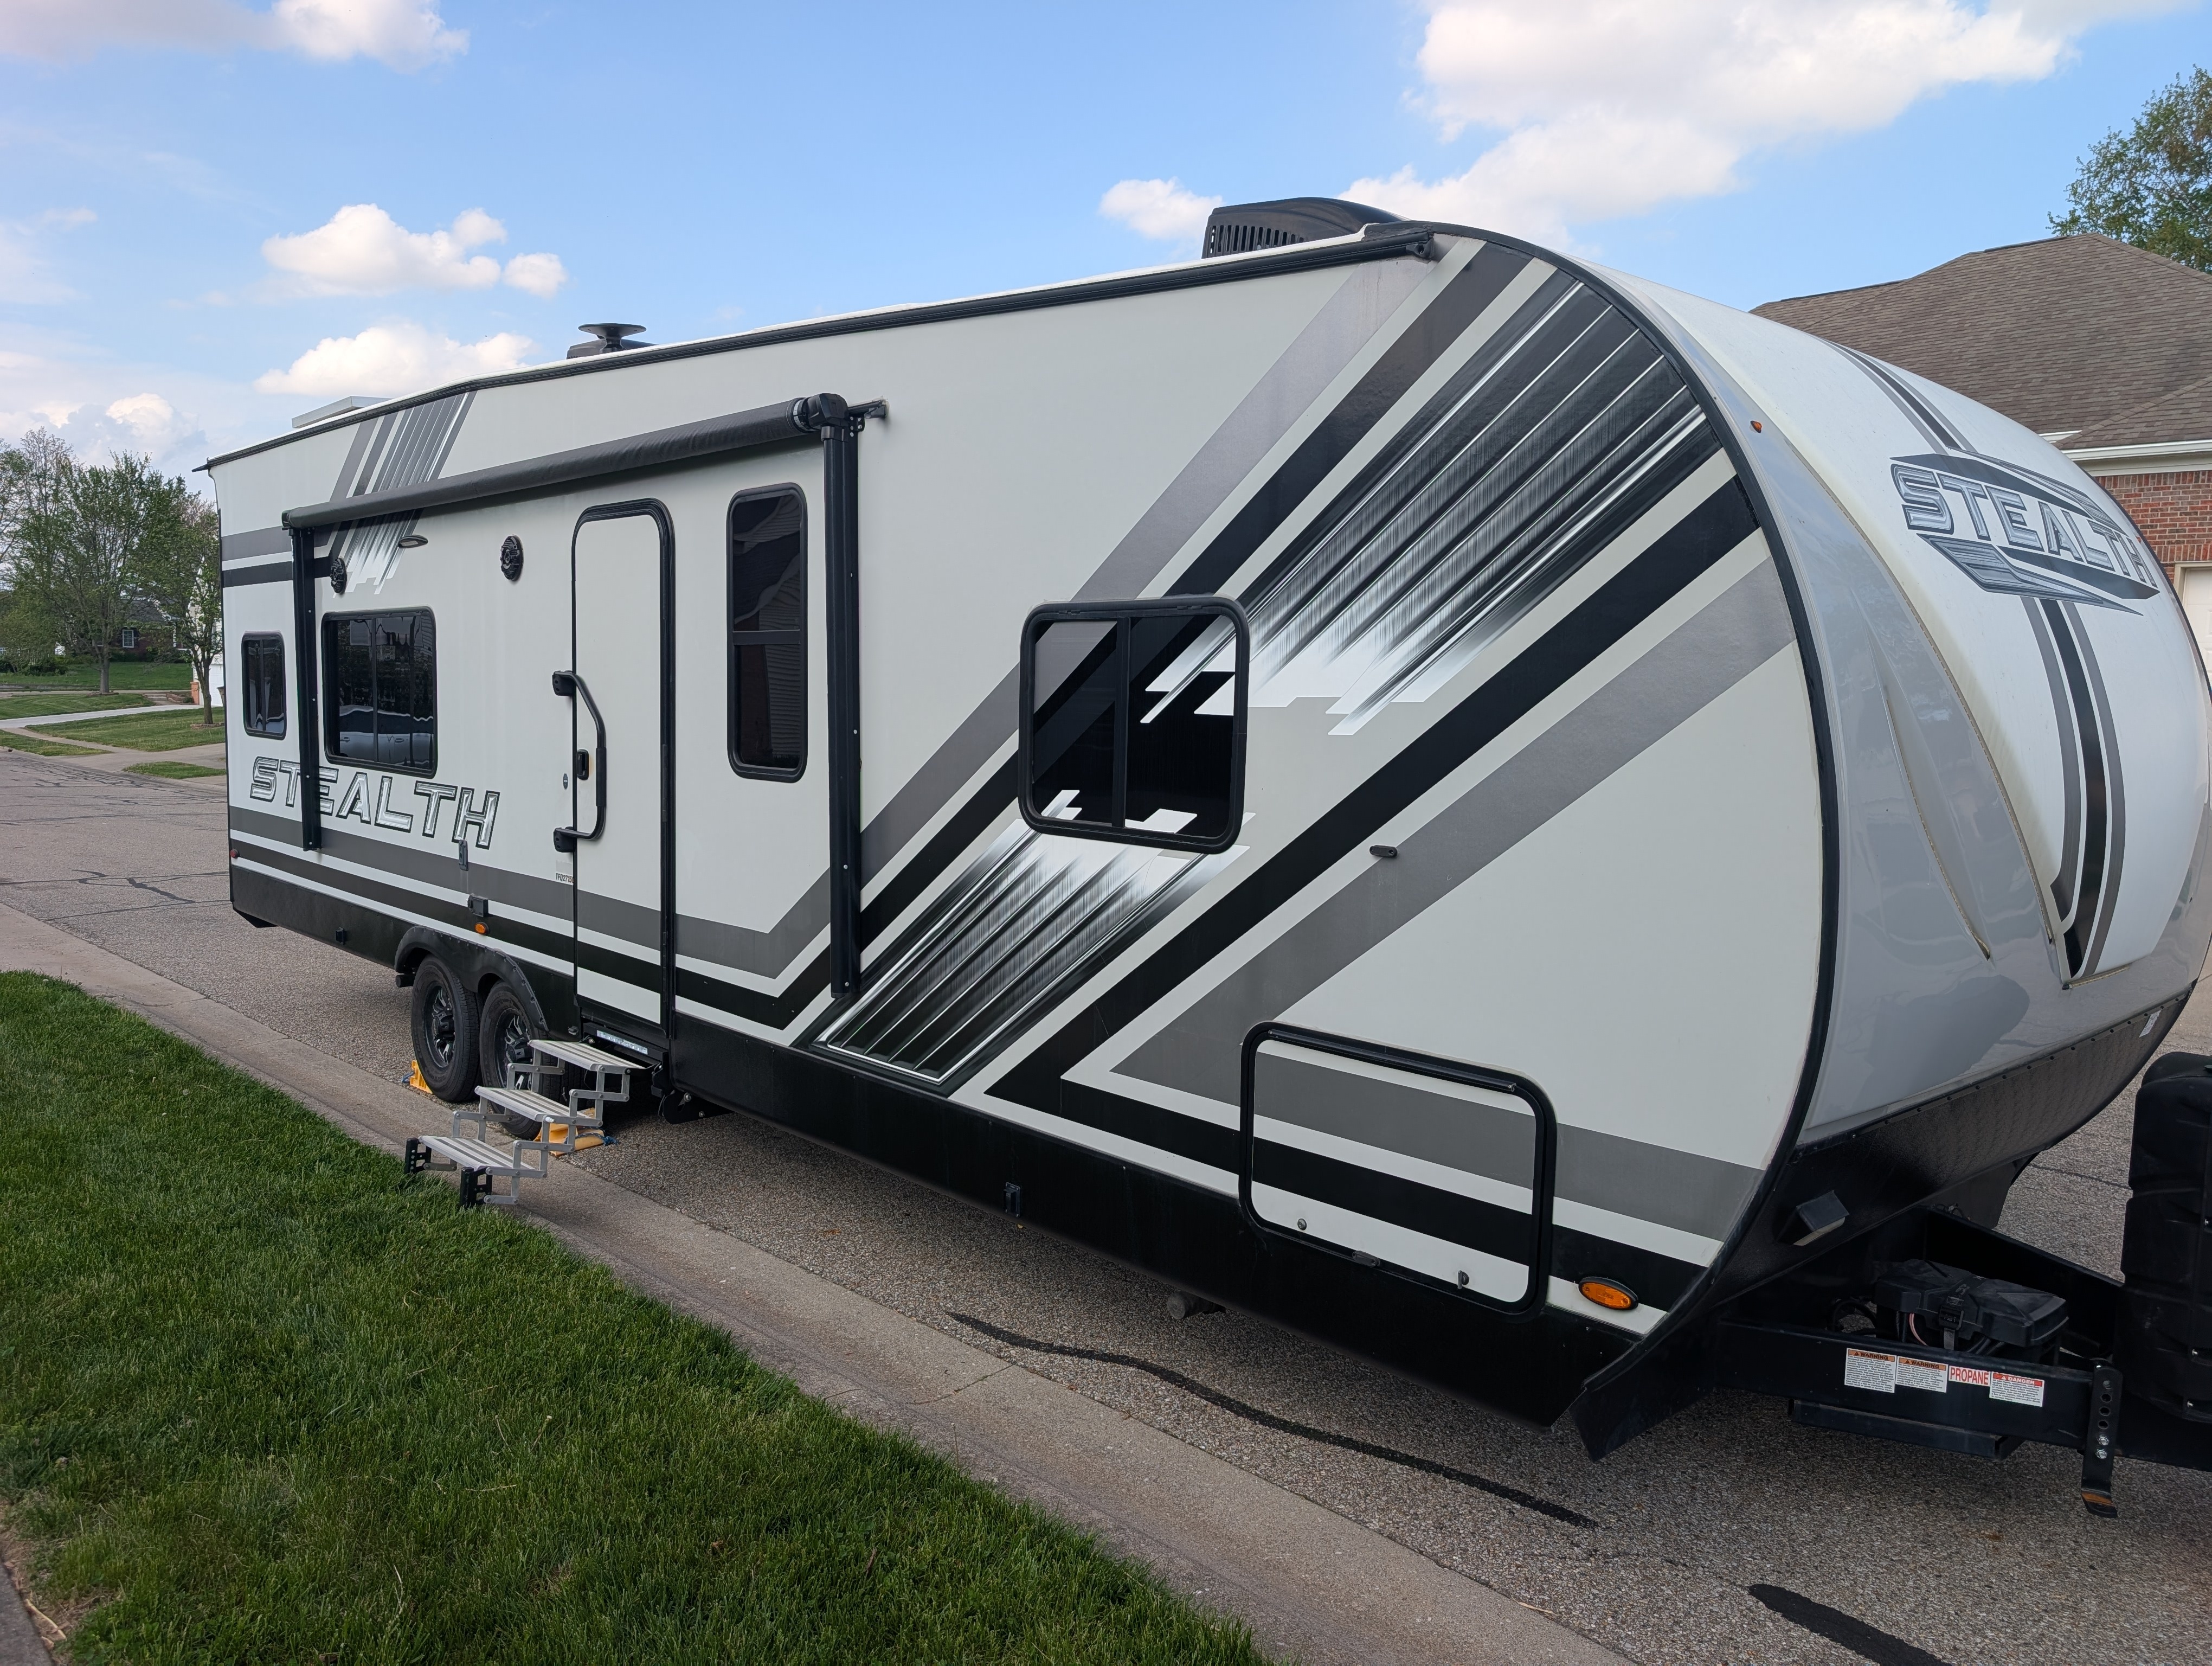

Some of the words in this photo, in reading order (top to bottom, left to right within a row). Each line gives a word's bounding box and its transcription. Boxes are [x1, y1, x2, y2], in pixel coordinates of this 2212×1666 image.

[1891, 463, 2158, 588] STEALTH
[250, 756, 500, 850] STEALTH
[1860, 1351, 1888, 1360] WARNING
[1911, 1360, 1940, 1369] WARNING
[1950, 1367, 1989, 1385] PROPANE
[2008, 1376, 2035, 1385] DANGER
